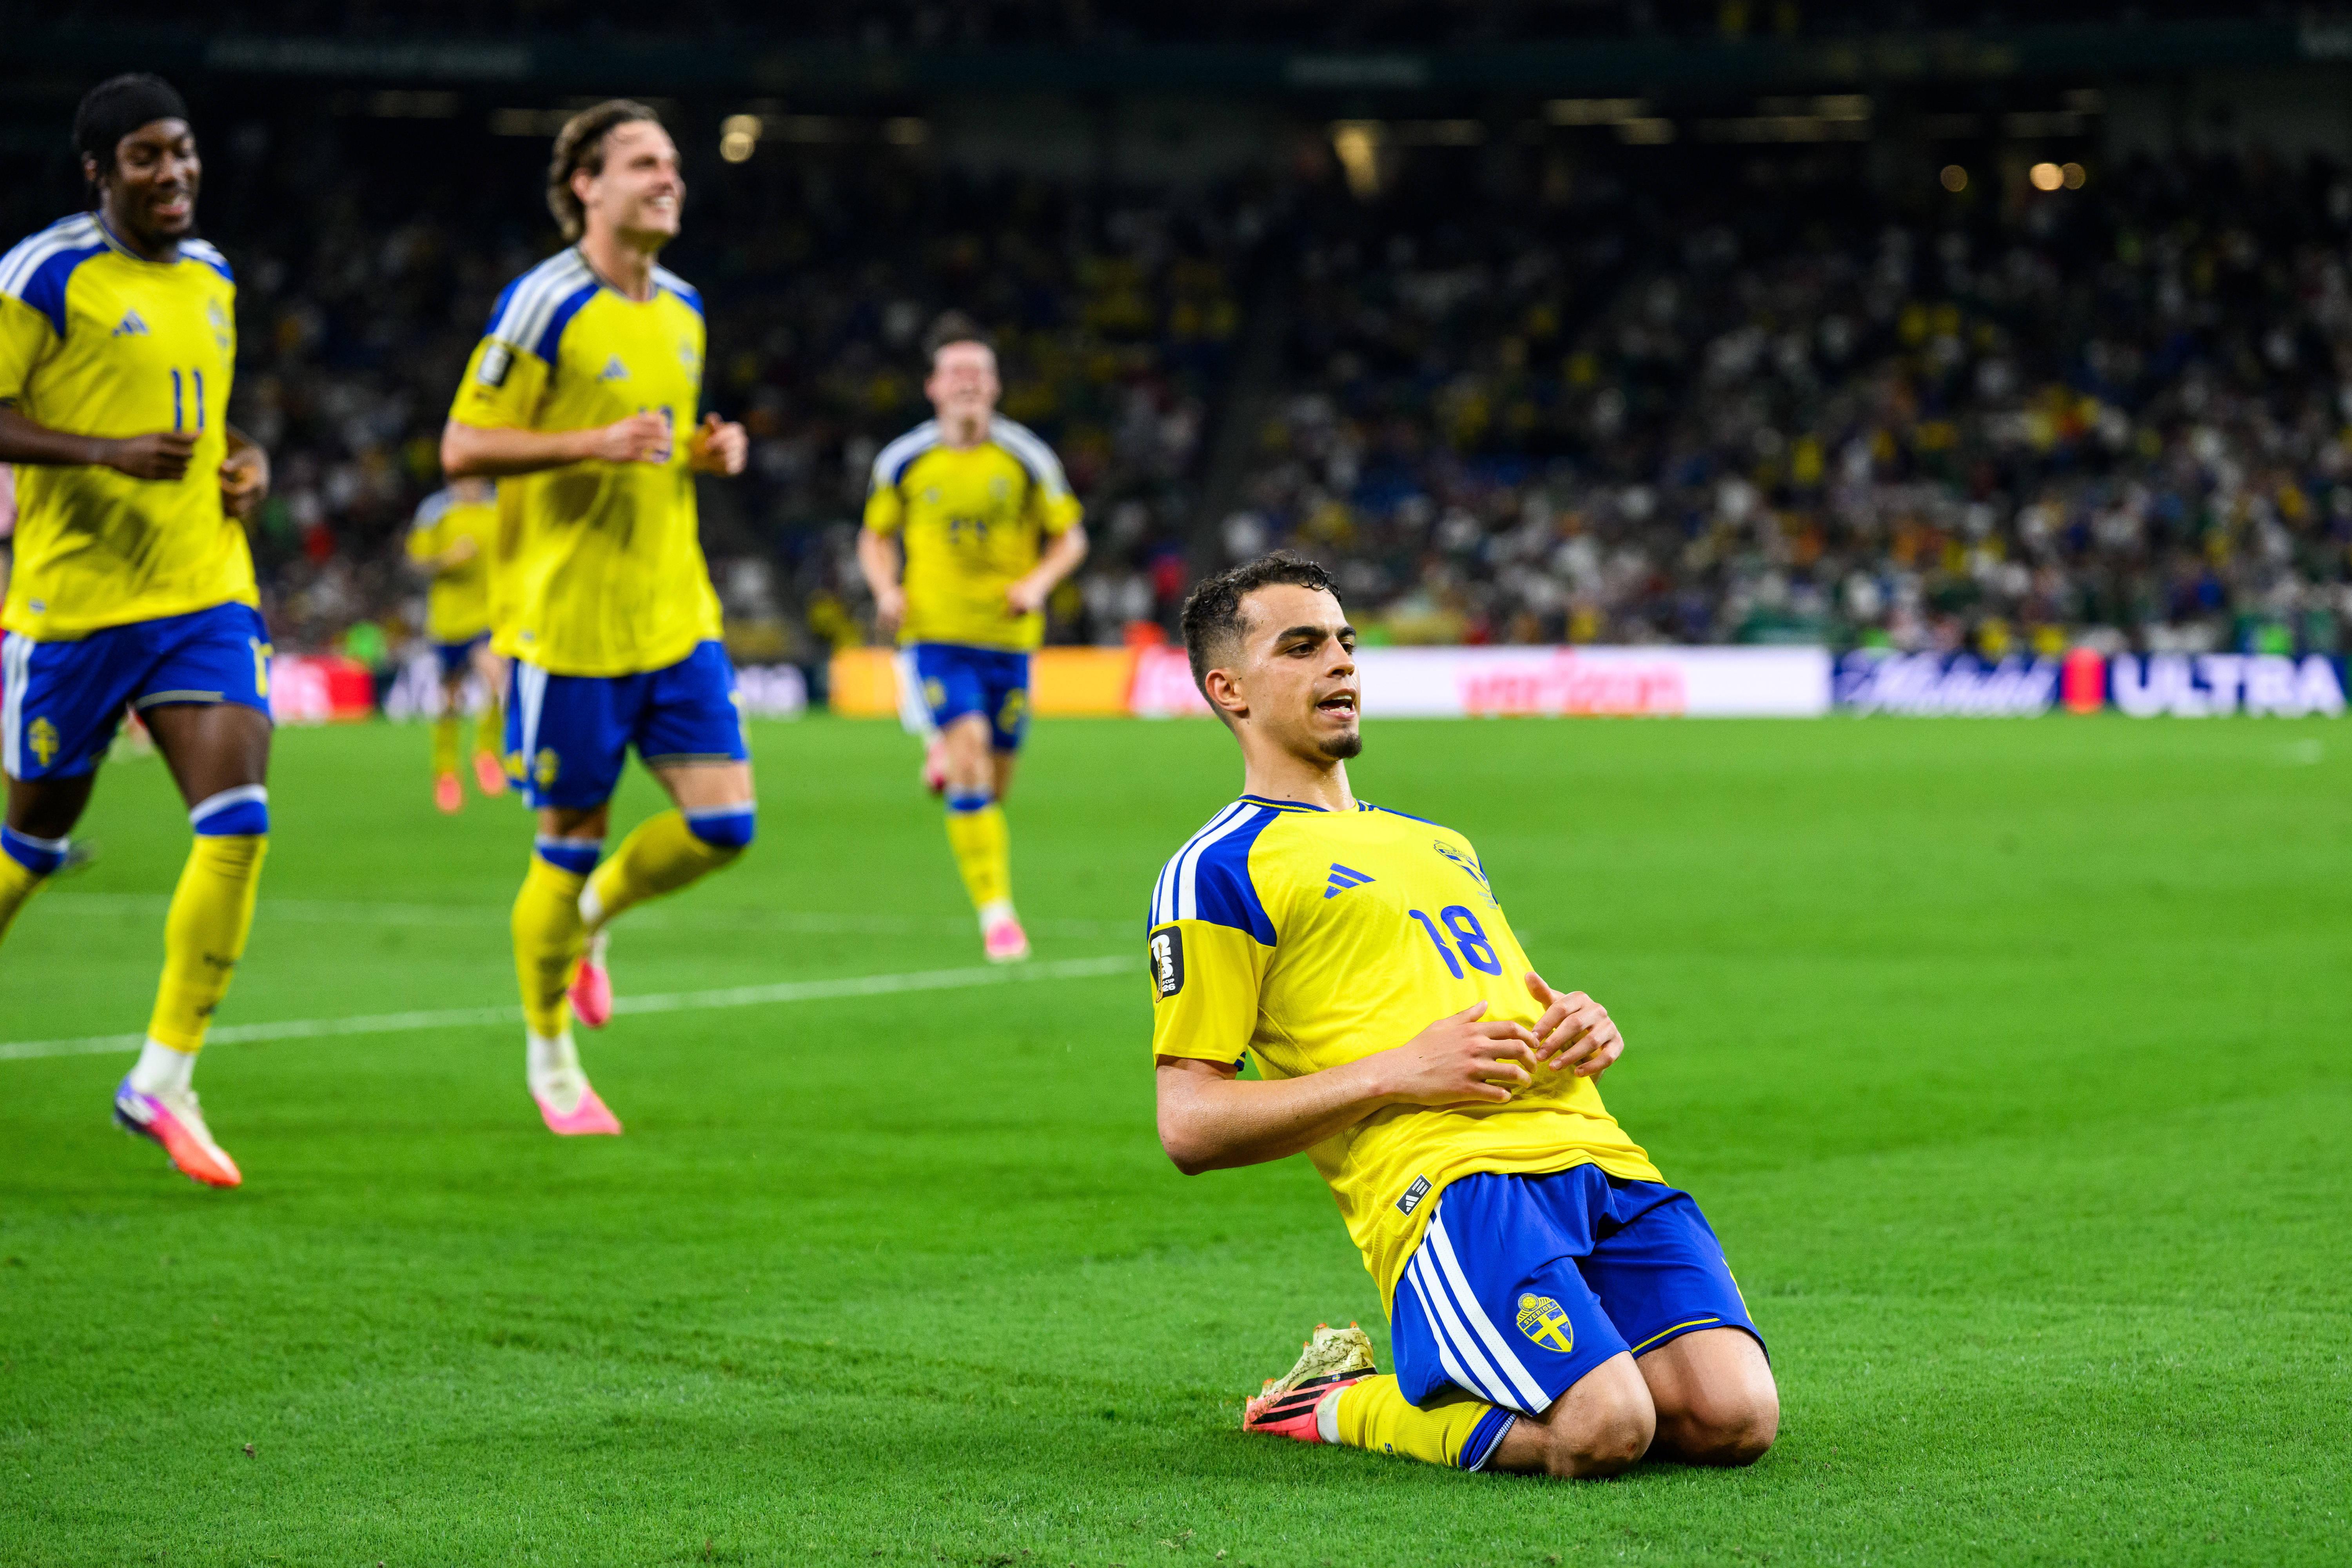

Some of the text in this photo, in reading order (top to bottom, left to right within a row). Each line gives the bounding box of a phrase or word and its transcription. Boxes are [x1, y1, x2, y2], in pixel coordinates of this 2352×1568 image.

[171, 369, 204, 432] 11
[2113, 652, 2344, 717] ULTRA
[1408, 905, 1502, 979] 18
[1412, 1178, 1422, 1191] AUTHENTIC
[1416, 1181, 1425, 1192] LICENSED
[1419, 1185, 1428, 1195] PRODUCT
[1524, 1304, 1552, 1325] SVERIGE
